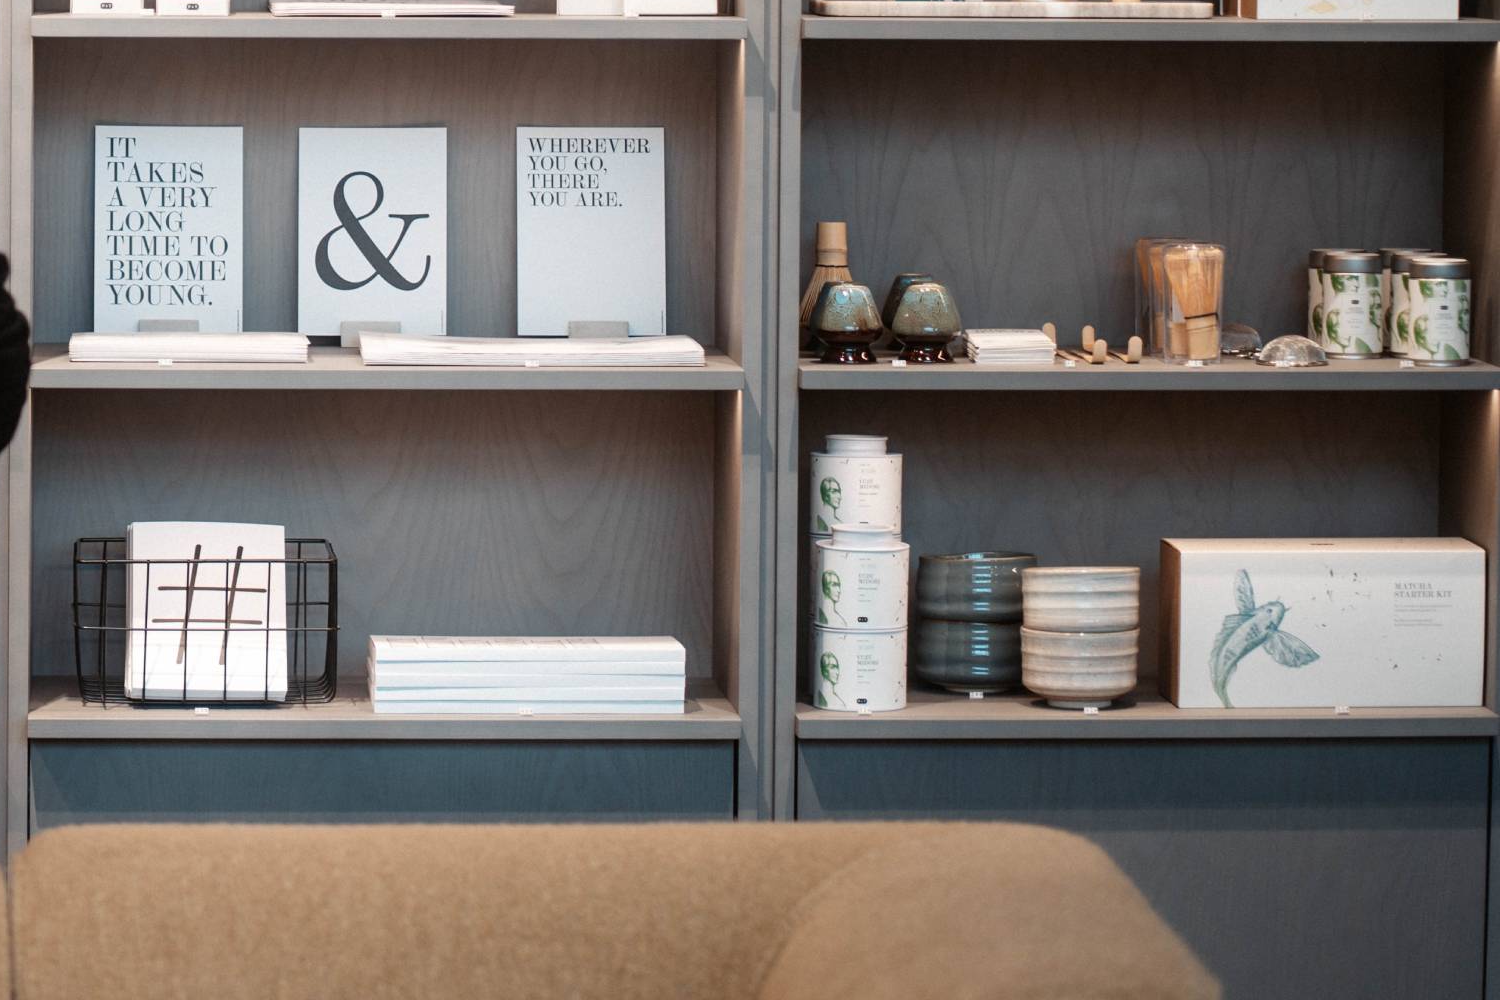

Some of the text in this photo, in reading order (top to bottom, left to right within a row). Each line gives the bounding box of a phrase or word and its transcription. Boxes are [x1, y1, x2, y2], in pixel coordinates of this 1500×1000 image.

[106, 137, 136, 158] IT
[528, 138, 651, 153] WHEREVER
[107, 161, 204, 183] TAKES
[528, 156, 607, 173] YOU GO,
[528, 174, 599, 189] THERE
[107, 186, 217, 207] A VERY
[528, 191, 622, 207] YOU ARE.
[107, 210, 186, 232] LONG
[315, 171, 431, 291] &
[107, 235, 228, 256] TIME TO
[106, 259, 226, 281] BECOME
[106, 284, 212, 306] YOUNG.
